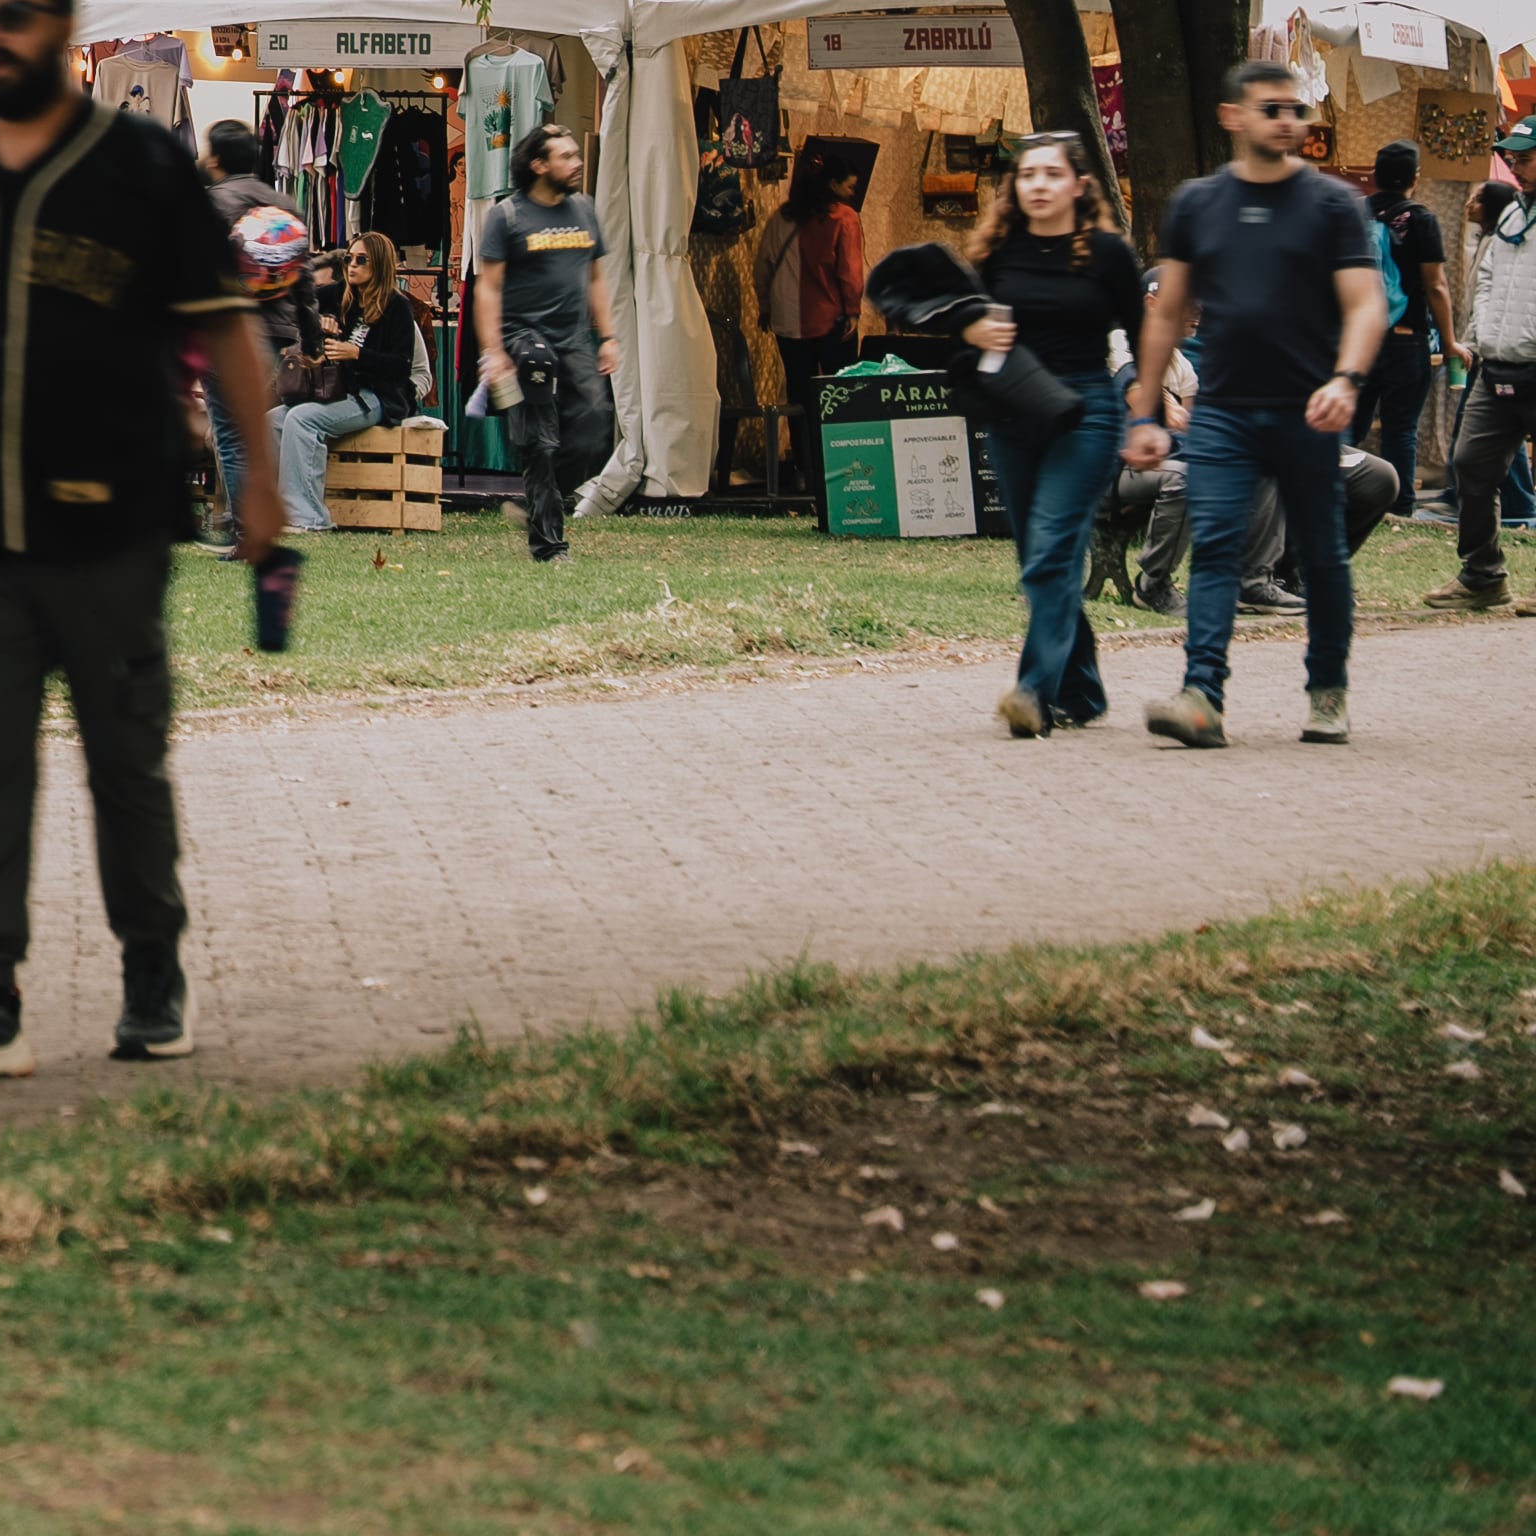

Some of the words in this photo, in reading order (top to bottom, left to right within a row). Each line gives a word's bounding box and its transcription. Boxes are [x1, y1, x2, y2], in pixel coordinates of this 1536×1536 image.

[269, 34, 288, 50] 20
[336, 32, 431, 55] ALFABETO
[823, 34, 842, 51] 18
[902, 22, 992, 51] ZABRILÚ
[905, 403, 949, 413] IMPACTA
